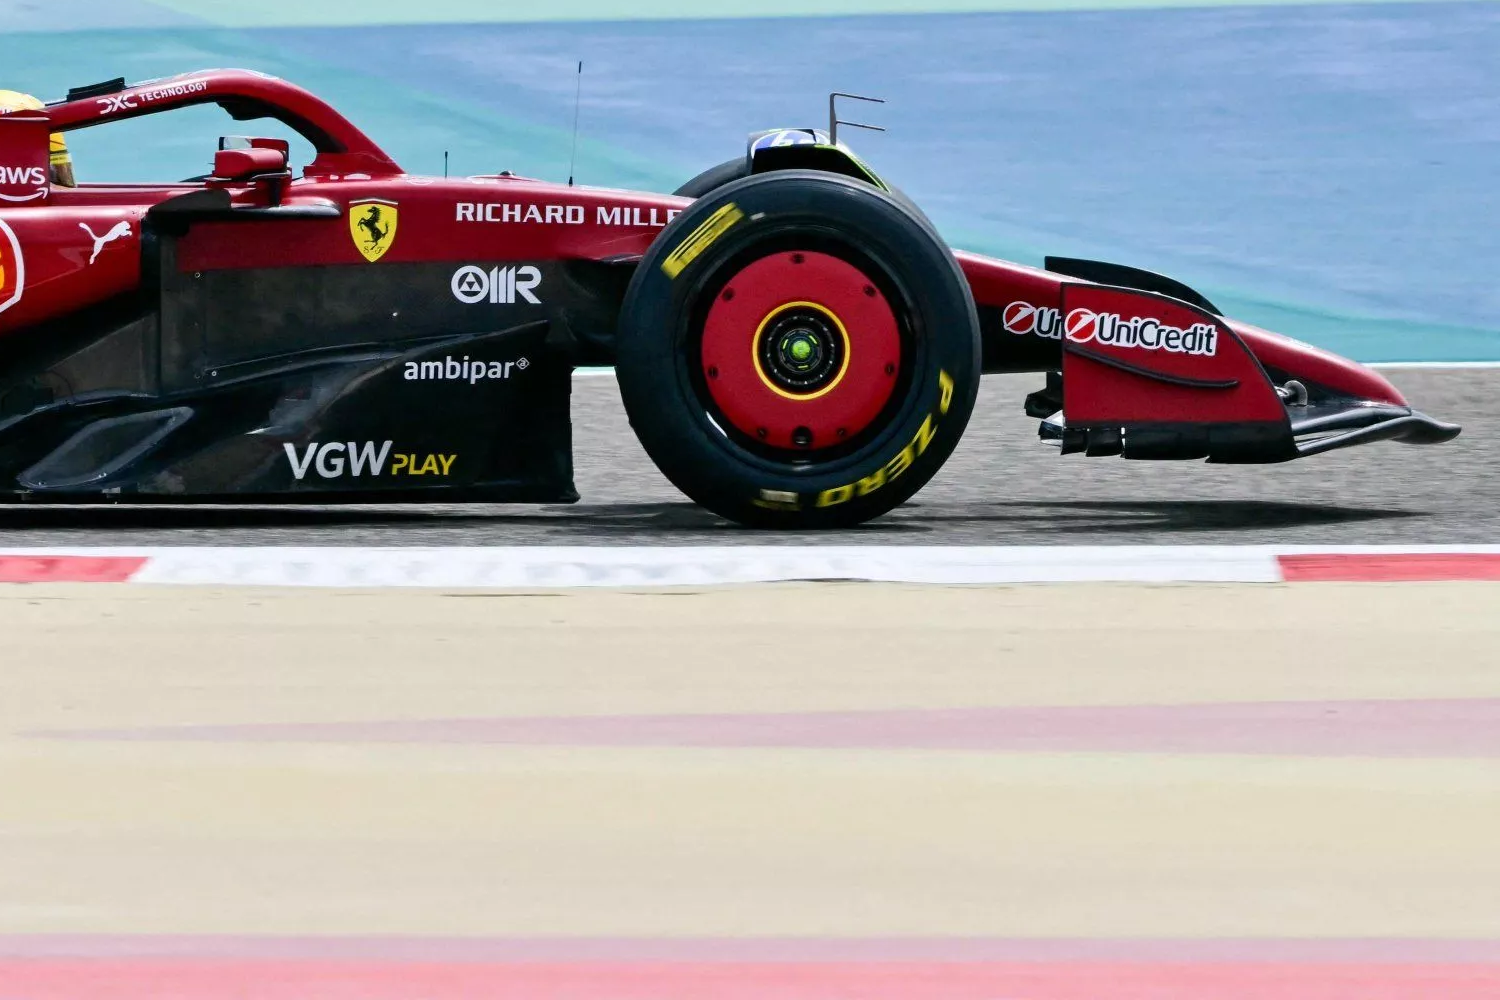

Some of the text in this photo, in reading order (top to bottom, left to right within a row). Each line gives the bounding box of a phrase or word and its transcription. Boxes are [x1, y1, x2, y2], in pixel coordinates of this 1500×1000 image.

[96, 81, 207, 115] DXC TECHNOLOGY
[456, 202, 585, 225] RICHARD
[1097, 313, 1217, 355] UniCredit
[403, 356, 515, 384] ambipar
[815, 368, 954, 508] P ZERO
[283, 440, 457, 480] VGW PLAY
